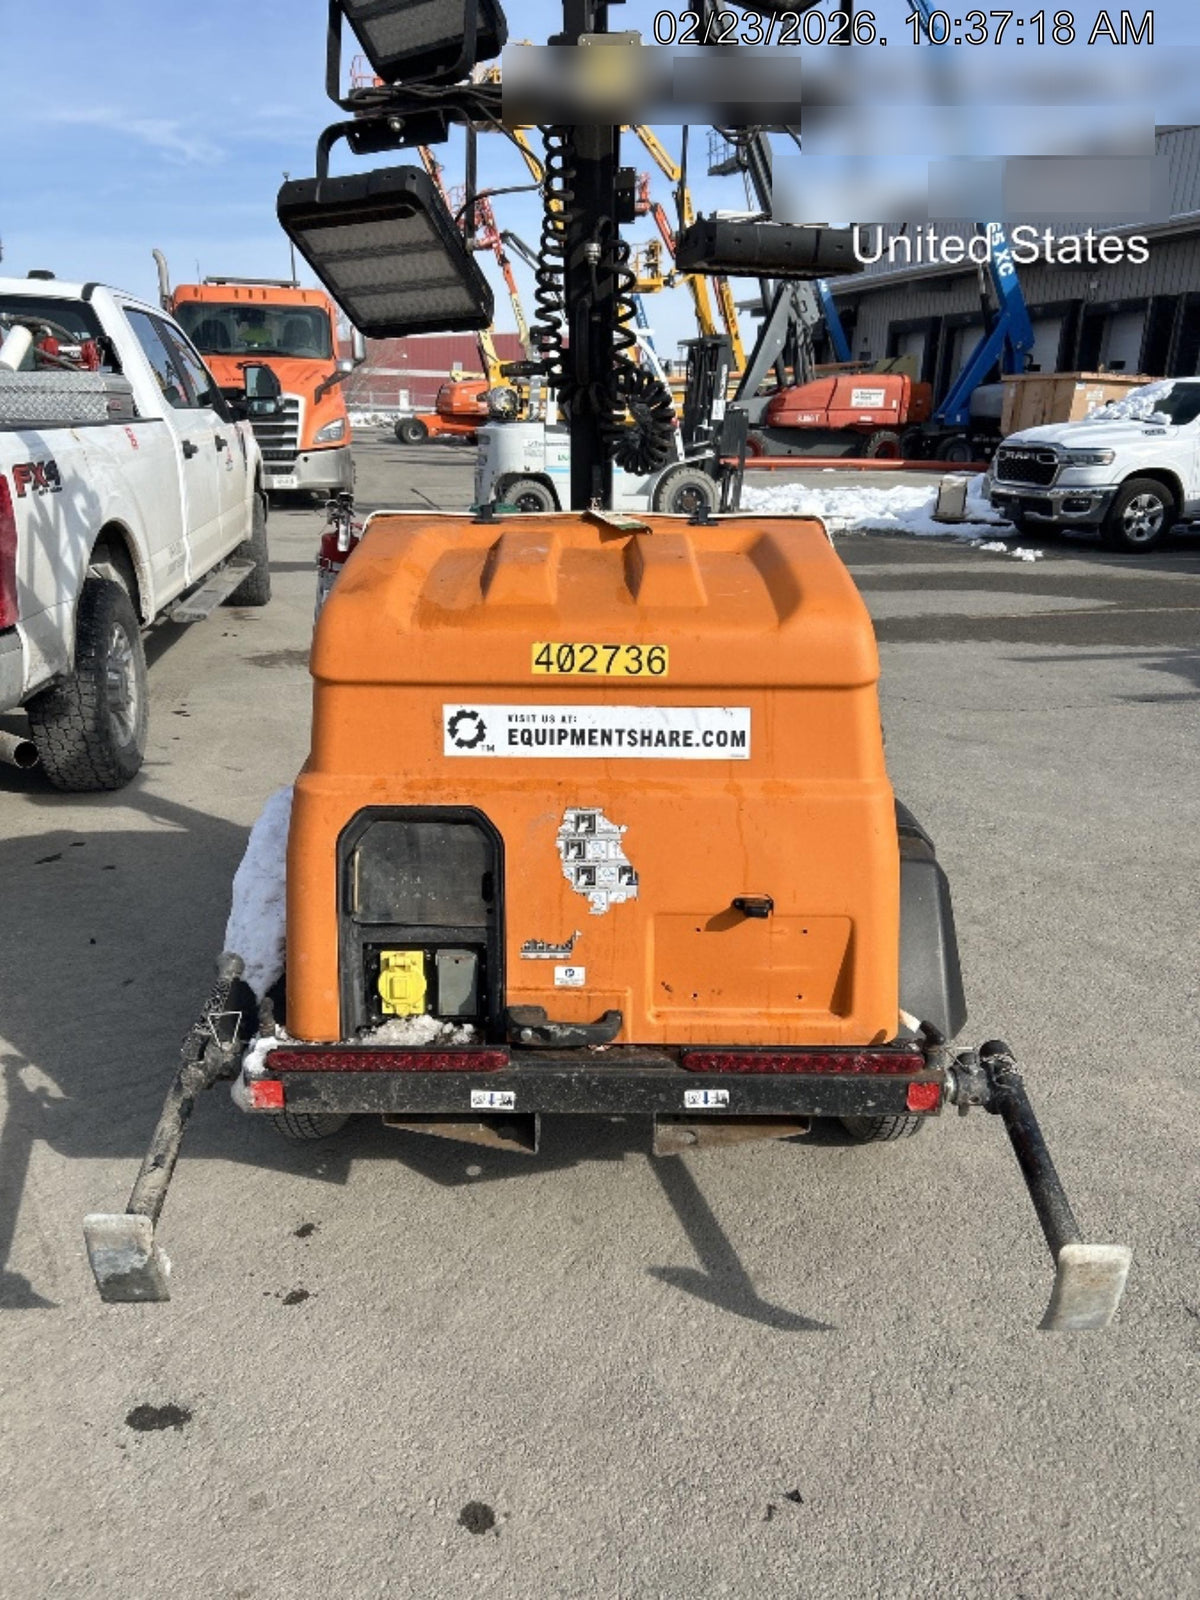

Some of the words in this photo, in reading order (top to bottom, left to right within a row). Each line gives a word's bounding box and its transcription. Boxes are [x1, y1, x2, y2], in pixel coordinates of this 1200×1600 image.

[994, 247, 1015, 277] XC
[12, 460, 61, 498] FX4
[534, 643, 666, 674] 402736
[507, 714, 537, 723] VISIT
[541, 714, 556, 723] US
[561, 715, 577, 724] AT:
[508, 728, 746, 748] EQUIPMENTSHARE.COM
